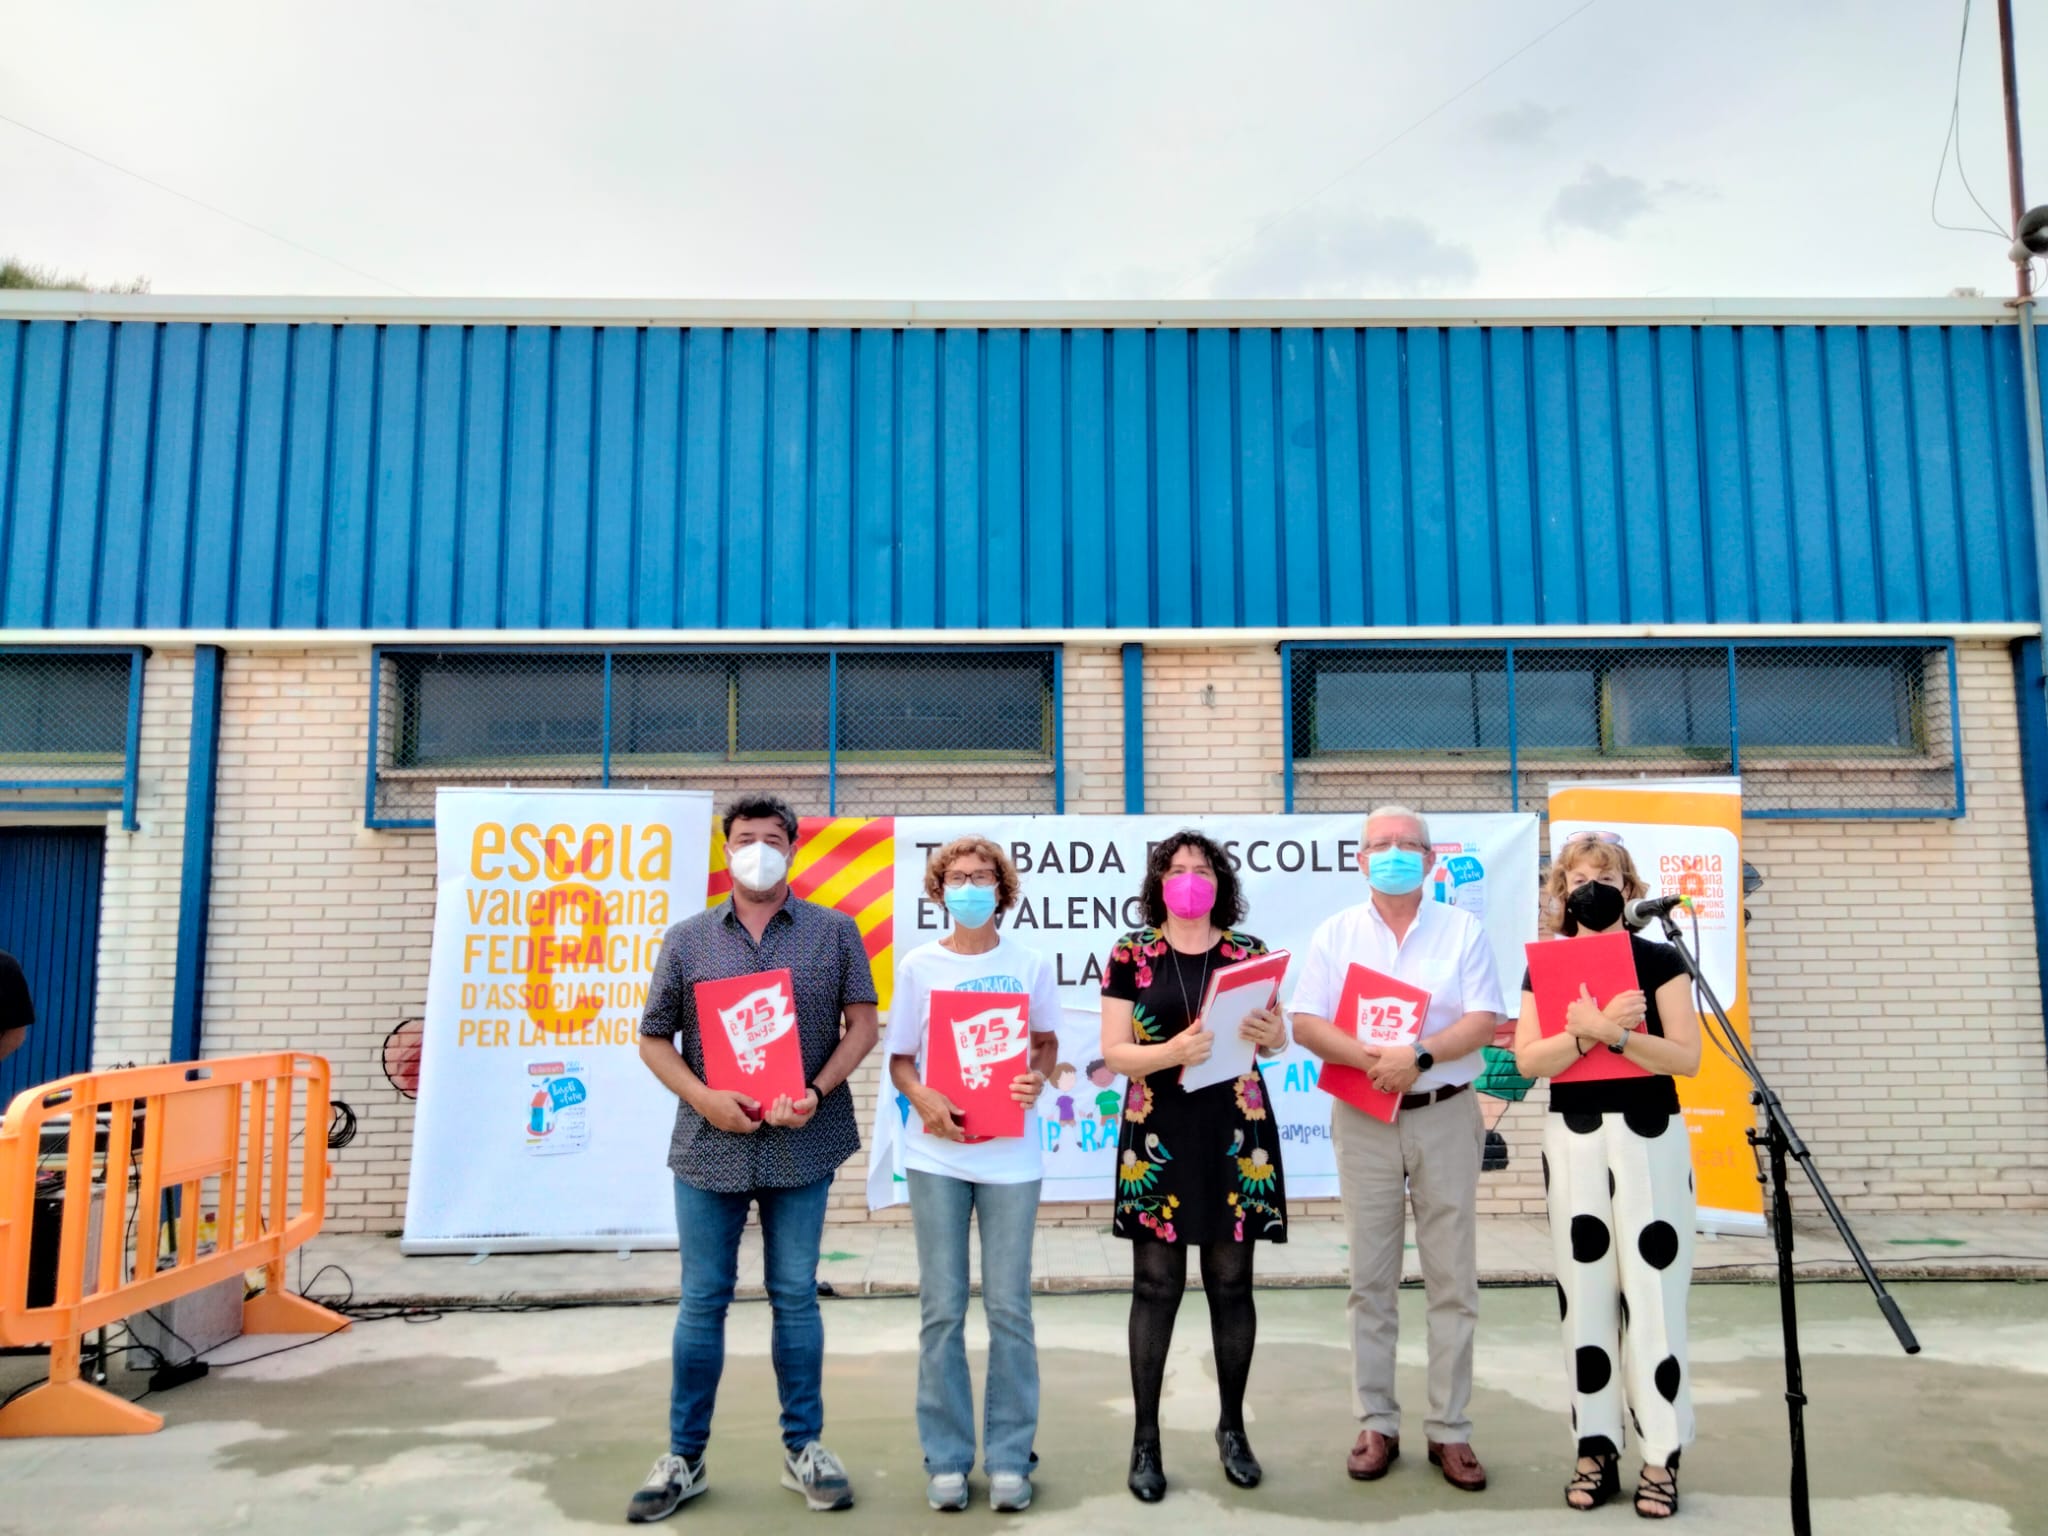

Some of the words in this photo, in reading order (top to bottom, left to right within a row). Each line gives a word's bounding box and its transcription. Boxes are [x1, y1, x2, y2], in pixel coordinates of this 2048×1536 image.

[470, 821, 673, 882] escola
[916, 841, 1126, 873] TBADA
[1660, 854, 1722, 873] escola
[466, 888, 670, 926] valenciana
[460, 982, 649, 1011] D'ASSOCIACION
[458, 1018, 510, 1047] PER
[518, 1018, 547, 1047] LA
[553, 1017, 643, 1046] LLENGU
